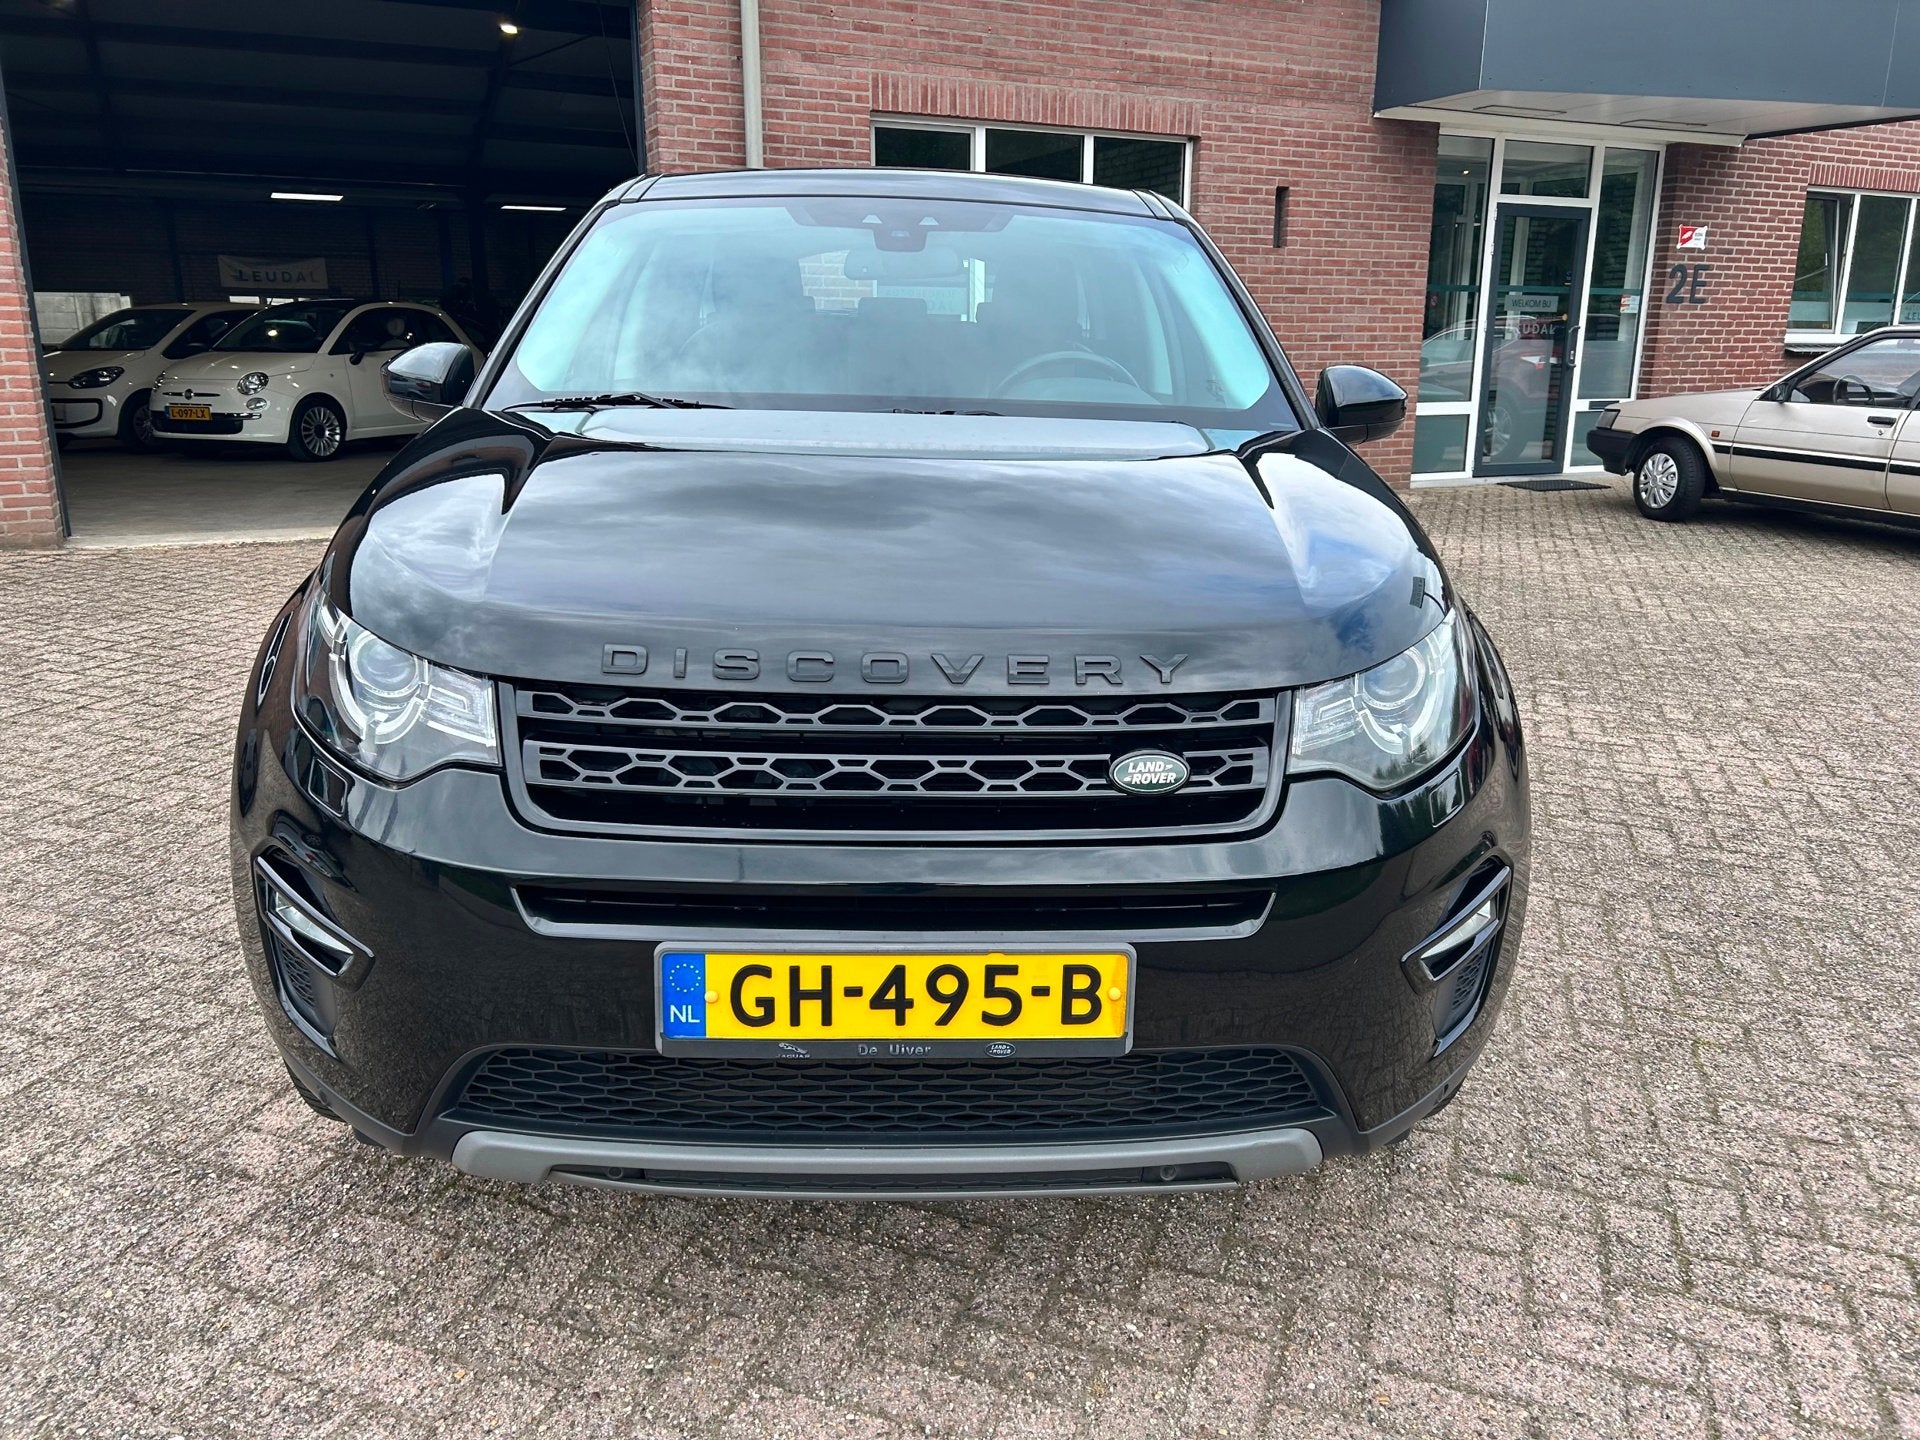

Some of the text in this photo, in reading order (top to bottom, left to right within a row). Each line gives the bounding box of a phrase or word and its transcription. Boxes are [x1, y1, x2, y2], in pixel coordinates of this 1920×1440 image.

[234, 269, 321, 283] LEUDAL
[1666, 263, 1712, 304] 2E
[1511, 299, 1541, 308] WELKOM
[1509, 323, 1556, 335] UDAL
[171, 408, 207, 418] L-097-LX
[602, 642, 1188, 686] DISCOVERY
[1127, 761, 1165, 773] LAND
[1131, 772, 1177, 784] ROVER
[728, 963, 1103, 1029] GH-495-B
[669, 1005, 701, 1024] NL
[858, 1044, 878, 1056] De
